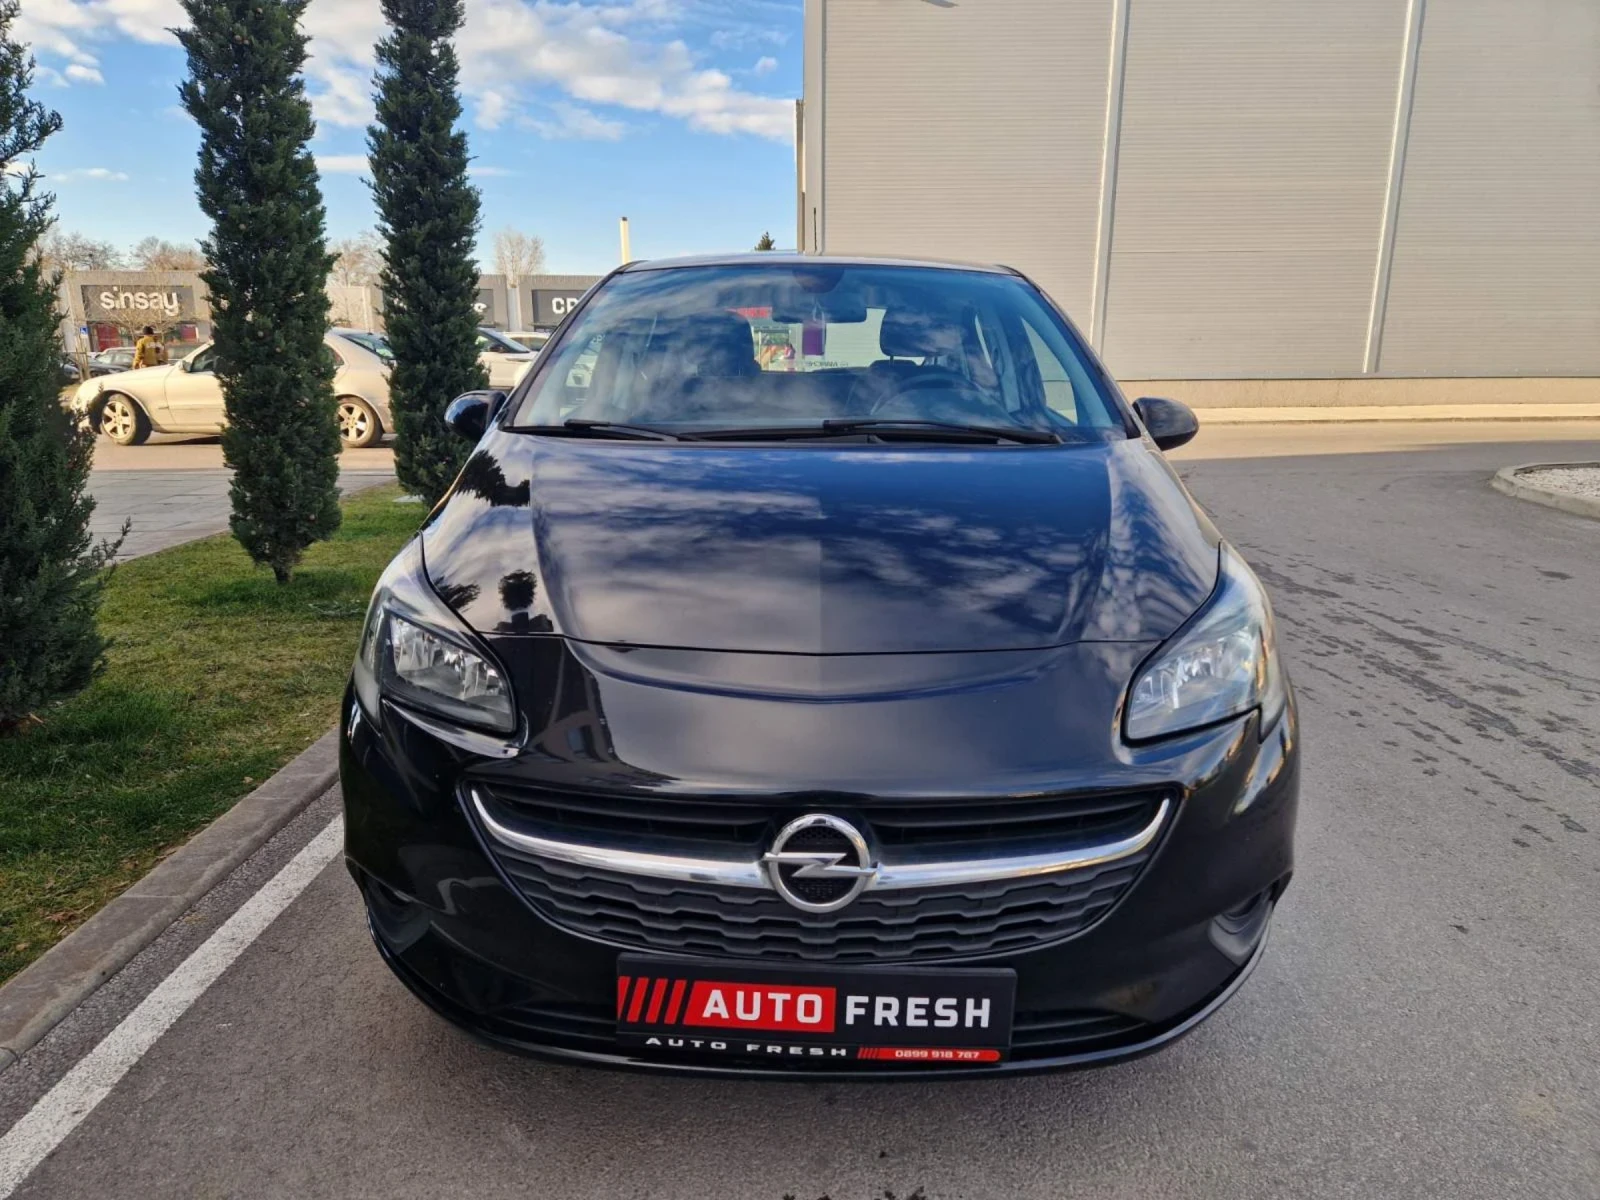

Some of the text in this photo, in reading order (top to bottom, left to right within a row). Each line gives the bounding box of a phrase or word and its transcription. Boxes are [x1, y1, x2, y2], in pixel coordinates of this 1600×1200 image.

[100, 286, 179, 317] sinsay
[702, 989, 991, 1028] AUTO FRESH
[645, 1037, 847, 1057] AUTO FRESH
[895, 1049, 929, 1058] 0899
[931, 1050, 953, 1059] 918
